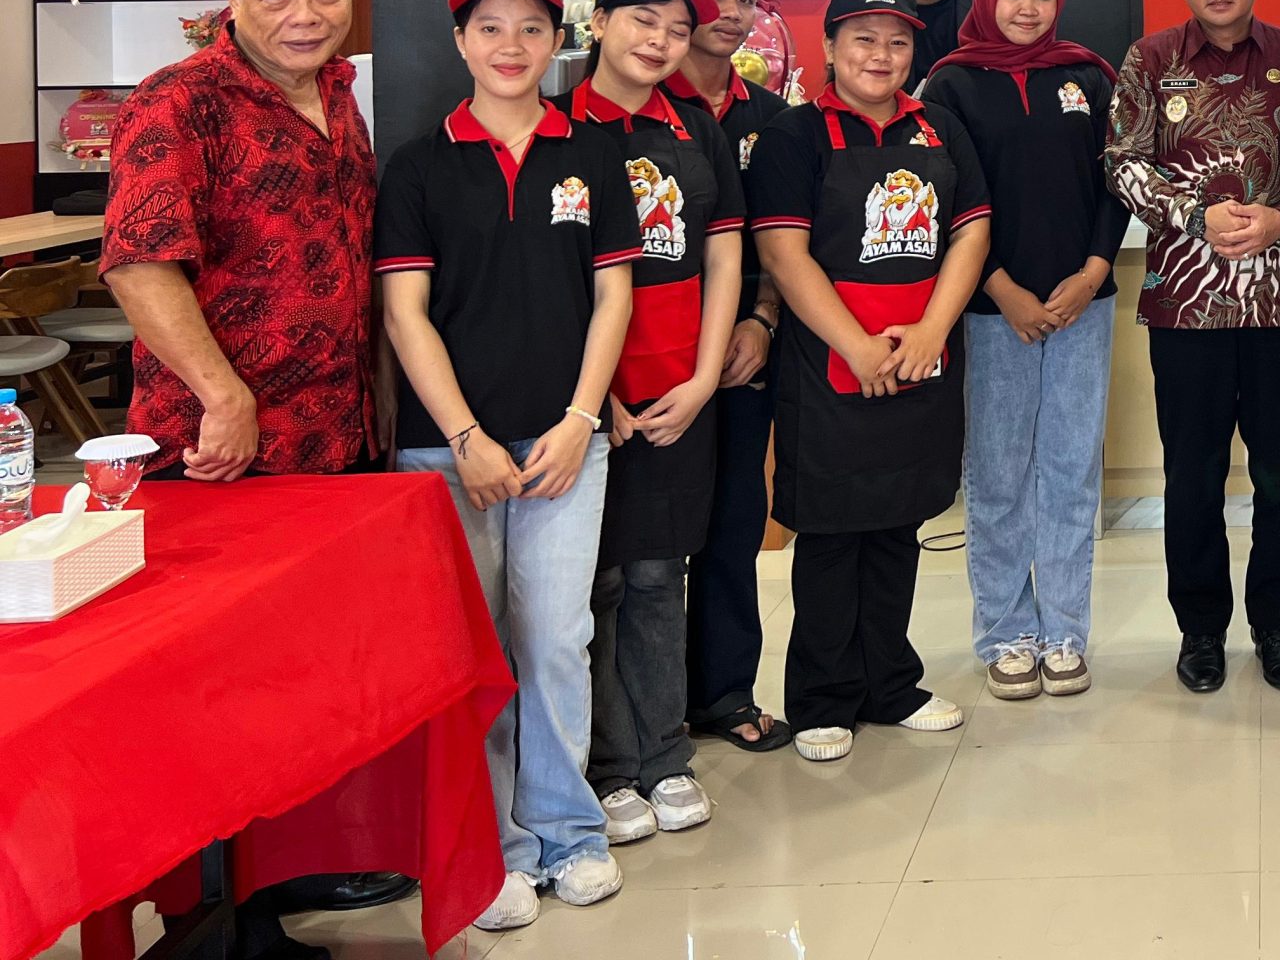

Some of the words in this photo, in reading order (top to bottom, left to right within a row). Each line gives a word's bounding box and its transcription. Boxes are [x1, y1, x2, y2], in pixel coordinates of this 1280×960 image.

[886, 229, 921, 241] RAJA
[642, 240, 683, 257] ASAP
[862, 241, 902, 259] AYAM
[904, 241, 937, 255] ASAP
